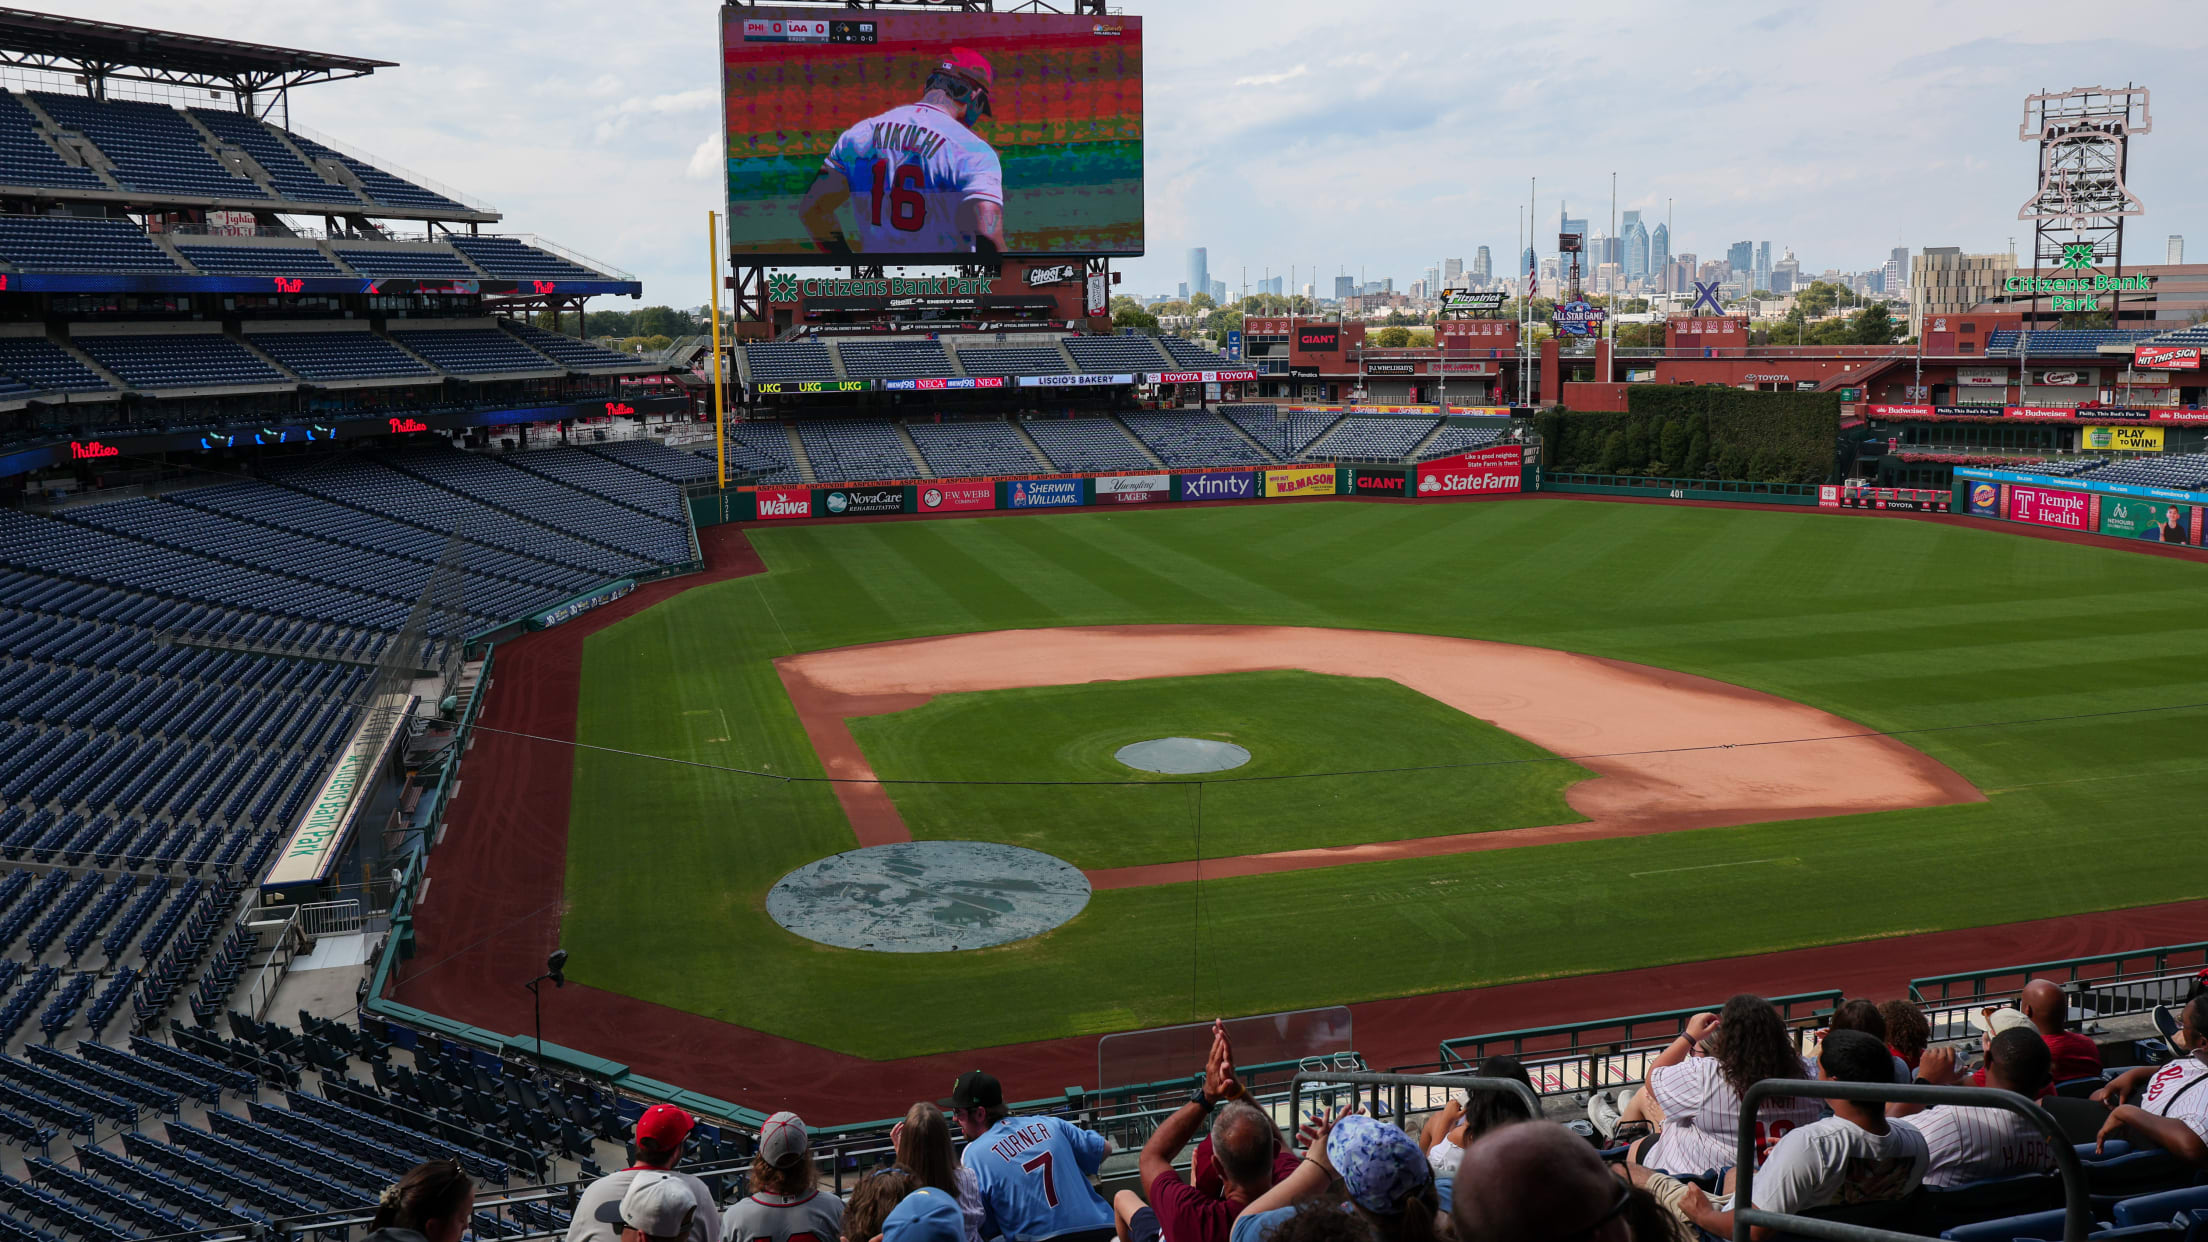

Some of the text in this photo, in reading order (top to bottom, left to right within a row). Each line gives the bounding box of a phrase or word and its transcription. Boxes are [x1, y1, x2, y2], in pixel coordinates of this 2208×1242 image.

[748, 23, 764, 32] PHI
[773, 23, 782, 33] 0
[815, 24, 825, 33] 0
[872, 121, 947, 160] KIKUCHI
[870, 158, 928, 232] 16
[1030, 265, 1066, 286] GHOST
[2005, 272, 2150, 293] Citizens Bank
[802, 275, 992, 297] Citizens Bank Park
[1446, 289, 1503, 304] Fitzpatrick
[2051, 294, 2098, 312] Park
[1552, 310, 1604, 321] ALL STAR GAME
[1301, 335, 1336, 344] GIANT
[2137, 356, 2152, 366] HIT
[2153, 351, 2174, 364] THIS
[2174, 348, 2198, 359] SIGN
[918, 380, 945, 388] NECA
[976, 378, 1003, 387] NECA
[1039, 375, 1114, 385] LISCIO'S BAKERY
[1164, 371, 1255, 382] TOYOTA TOYOTA
[1757, 374, 1790, 382] TOYOTA
[757, 381, 862, 393] UKG UKG UKG
[605, 402, 635, 416] Phillies
[388, 418, 428, 433] Phillies
[2117, 429, 2146, 438] PLAY
[2129, 438, 2157, 448] WIN!
[70, 441, 119, 460] Phillies
[1481, 453, 1495, 462] good
[1028, 482, 1075, 494] SHERWIN
[1110, 478, 1157, 492] Yuengling
[1185, 475, 1250, 497] xfinity
[1356, 476, 1406, 489] GIANT
[848, 491, 902, 504] NovaCare
[963, 489, 991, 499] WEBB
[1117, 492, 1148, 502] LAGER
[1669, 489, 1684, 499] 401
[759, 500, 809, 516] Wawa
[848, 504, 901, 512] REHABILITATION
[2038, 492, 2085, 512] Temple
[2038, 508, 2081, 526] Health
[305, 801, 347, 830] Bank
[288, 828, 336, 859] Park
[990, 1122, 1052, 1163] TURNER
[1021, 1149, 1060, 1208] 7
